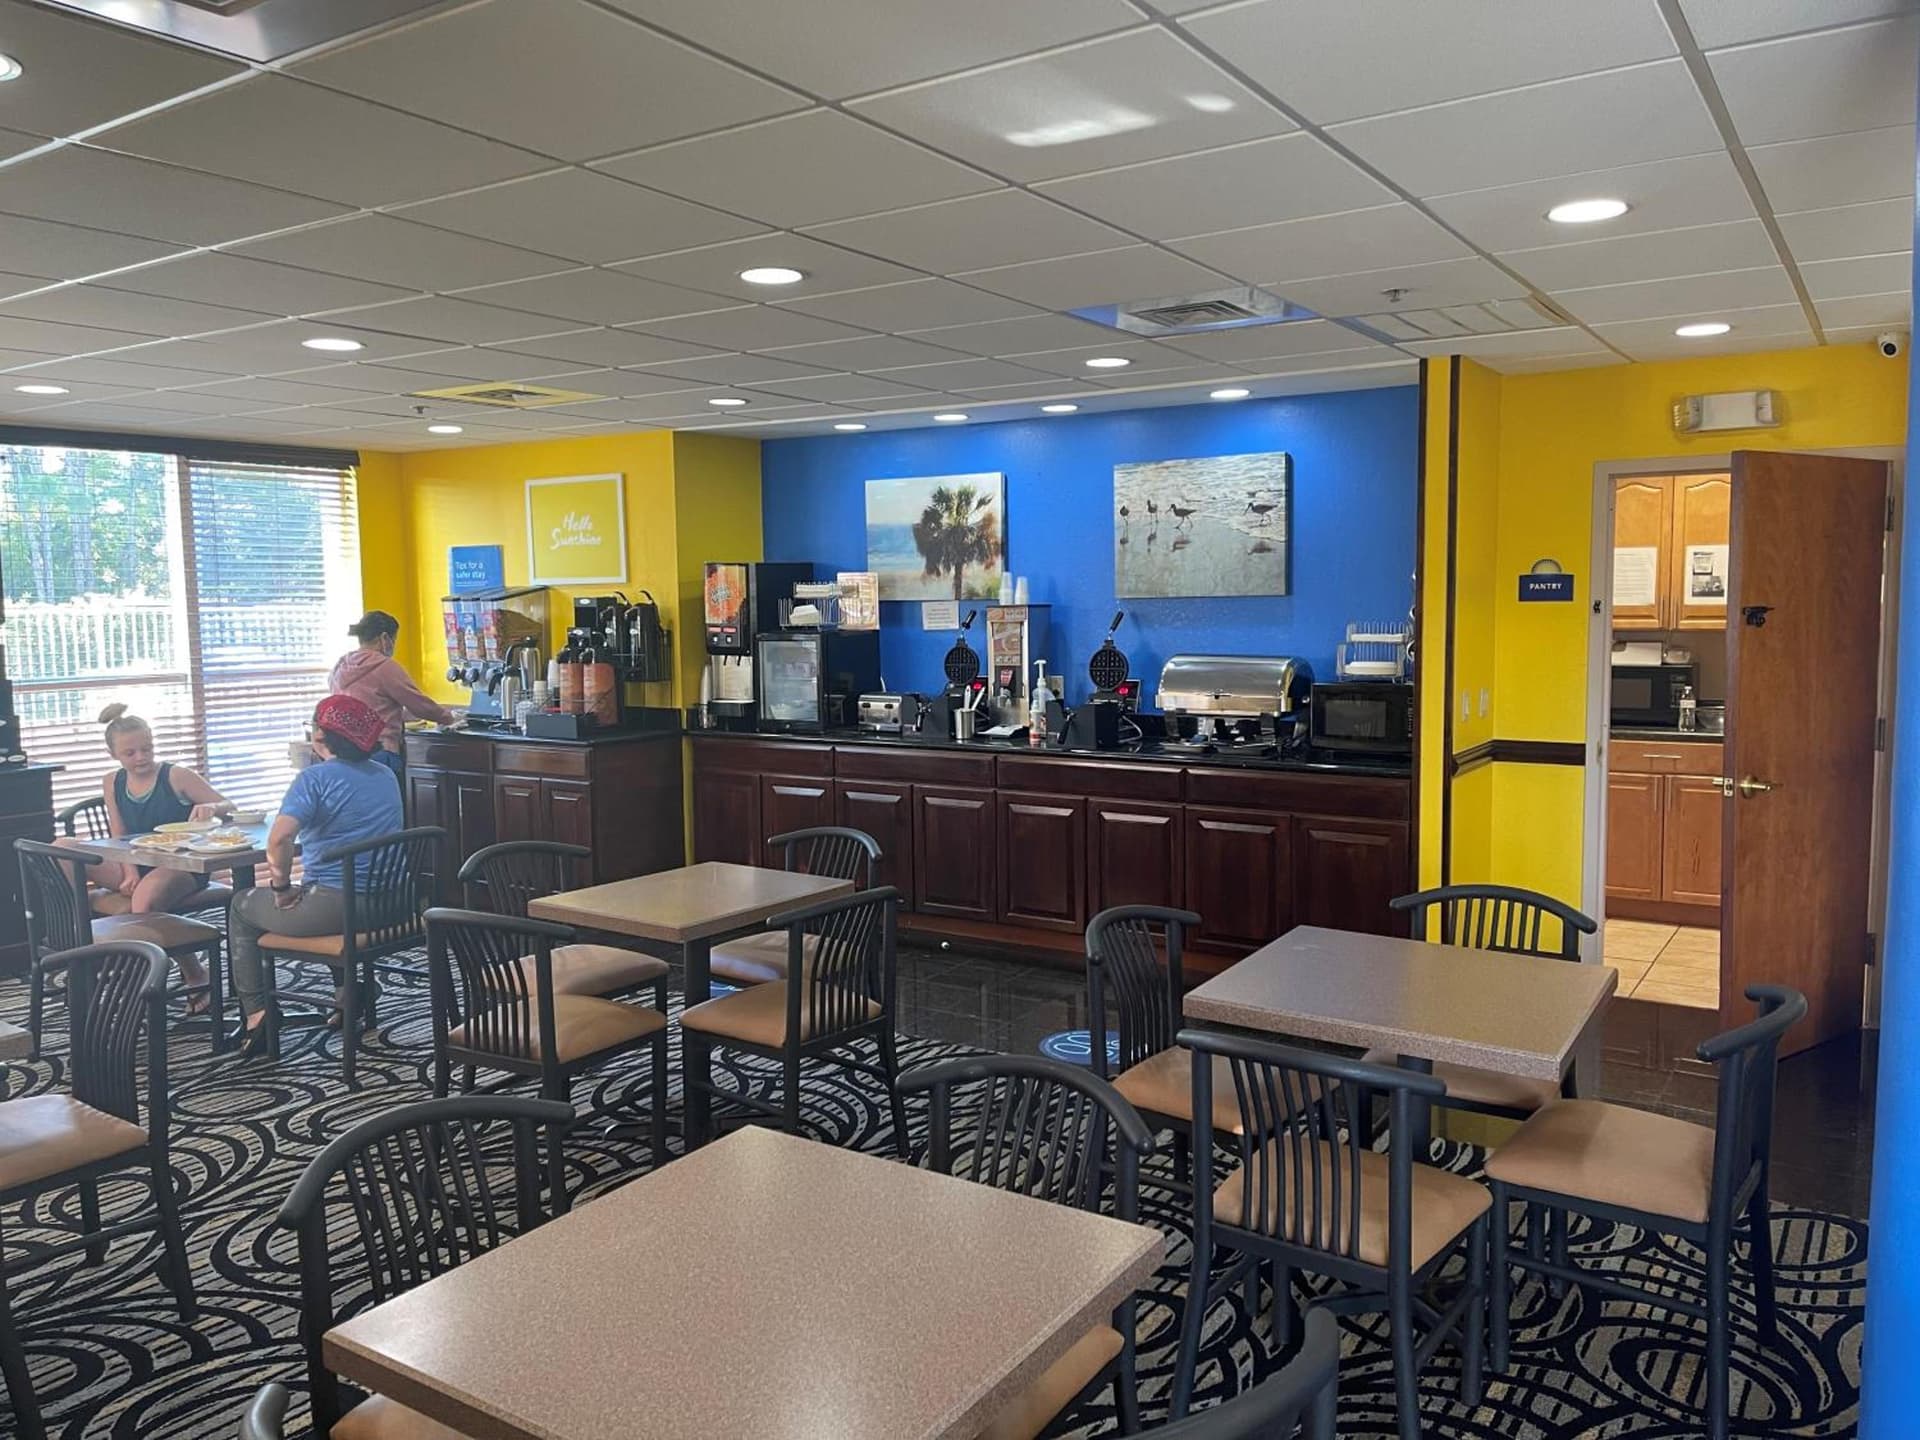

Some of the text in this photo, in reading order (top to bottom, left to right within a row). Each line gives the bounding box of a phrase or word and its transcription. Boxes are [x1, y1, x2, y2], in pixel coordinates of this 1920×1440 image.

[563, 512, 593, 531] Hello
[551, 528, 601, 550] Sunshine
[1529, 583, 1563, 591] PANTRY
